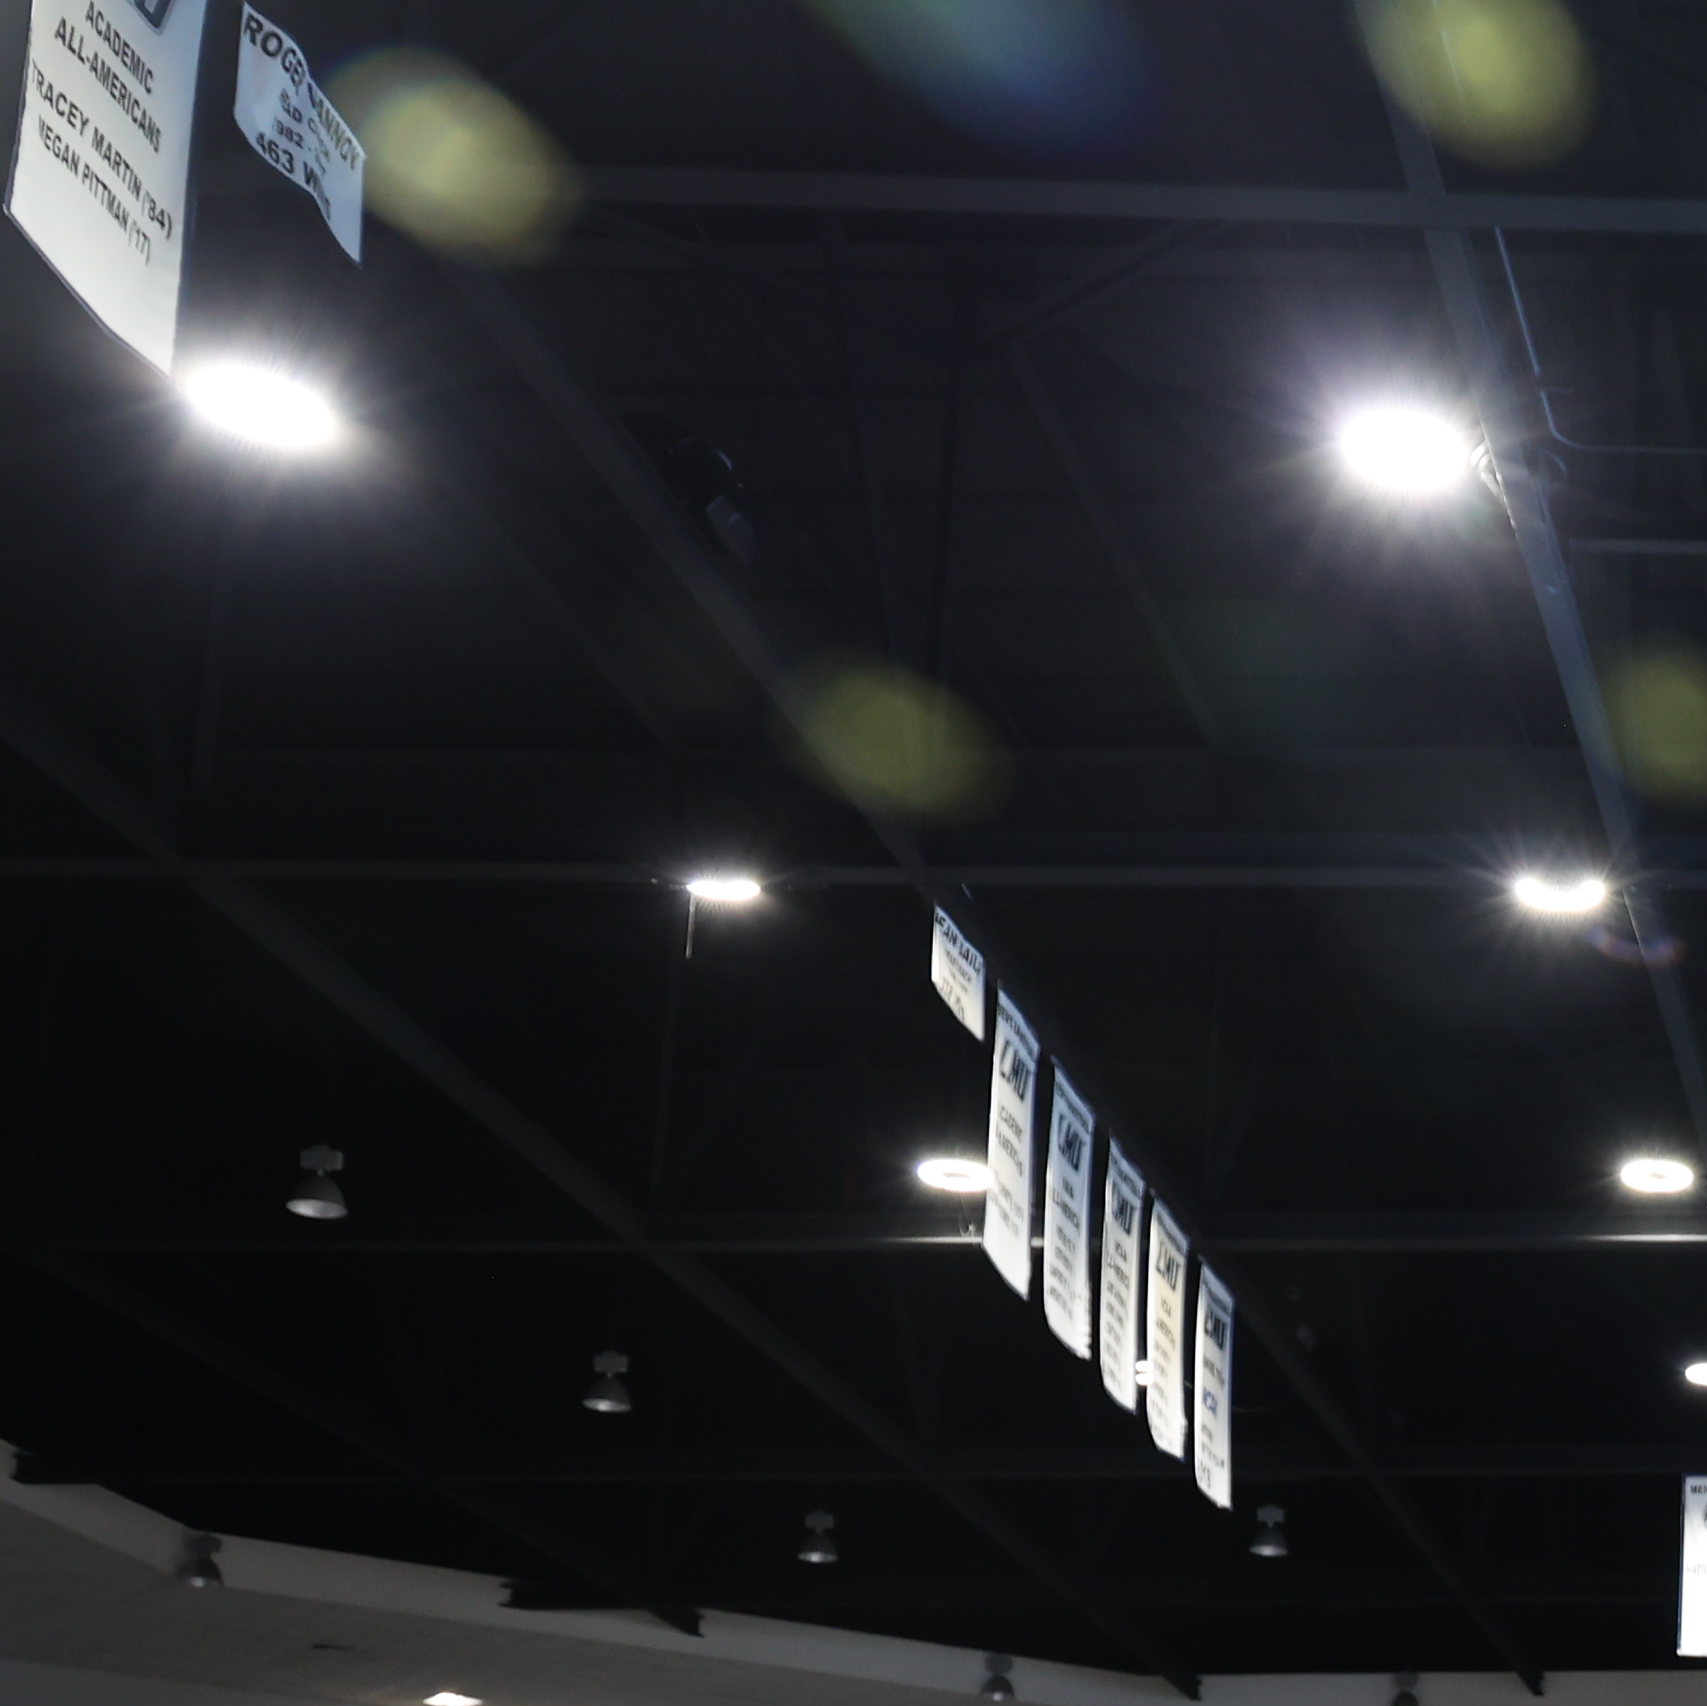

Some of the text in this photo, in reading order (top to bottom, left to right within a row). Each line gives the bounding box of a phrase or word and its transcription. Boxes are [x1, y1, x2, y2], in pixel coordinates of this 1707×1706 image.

[54, 17, 162, 153] ALL-AMERICANS
[85, 1, 153, 94] ACADEMIC
[32, 60, 90, 136] TRACEY
[91, 126, 142, 201] MARTIN
[82, 164, 127, 232] PITTMAN
[1000, 1040, 1029, 1104] LMU
